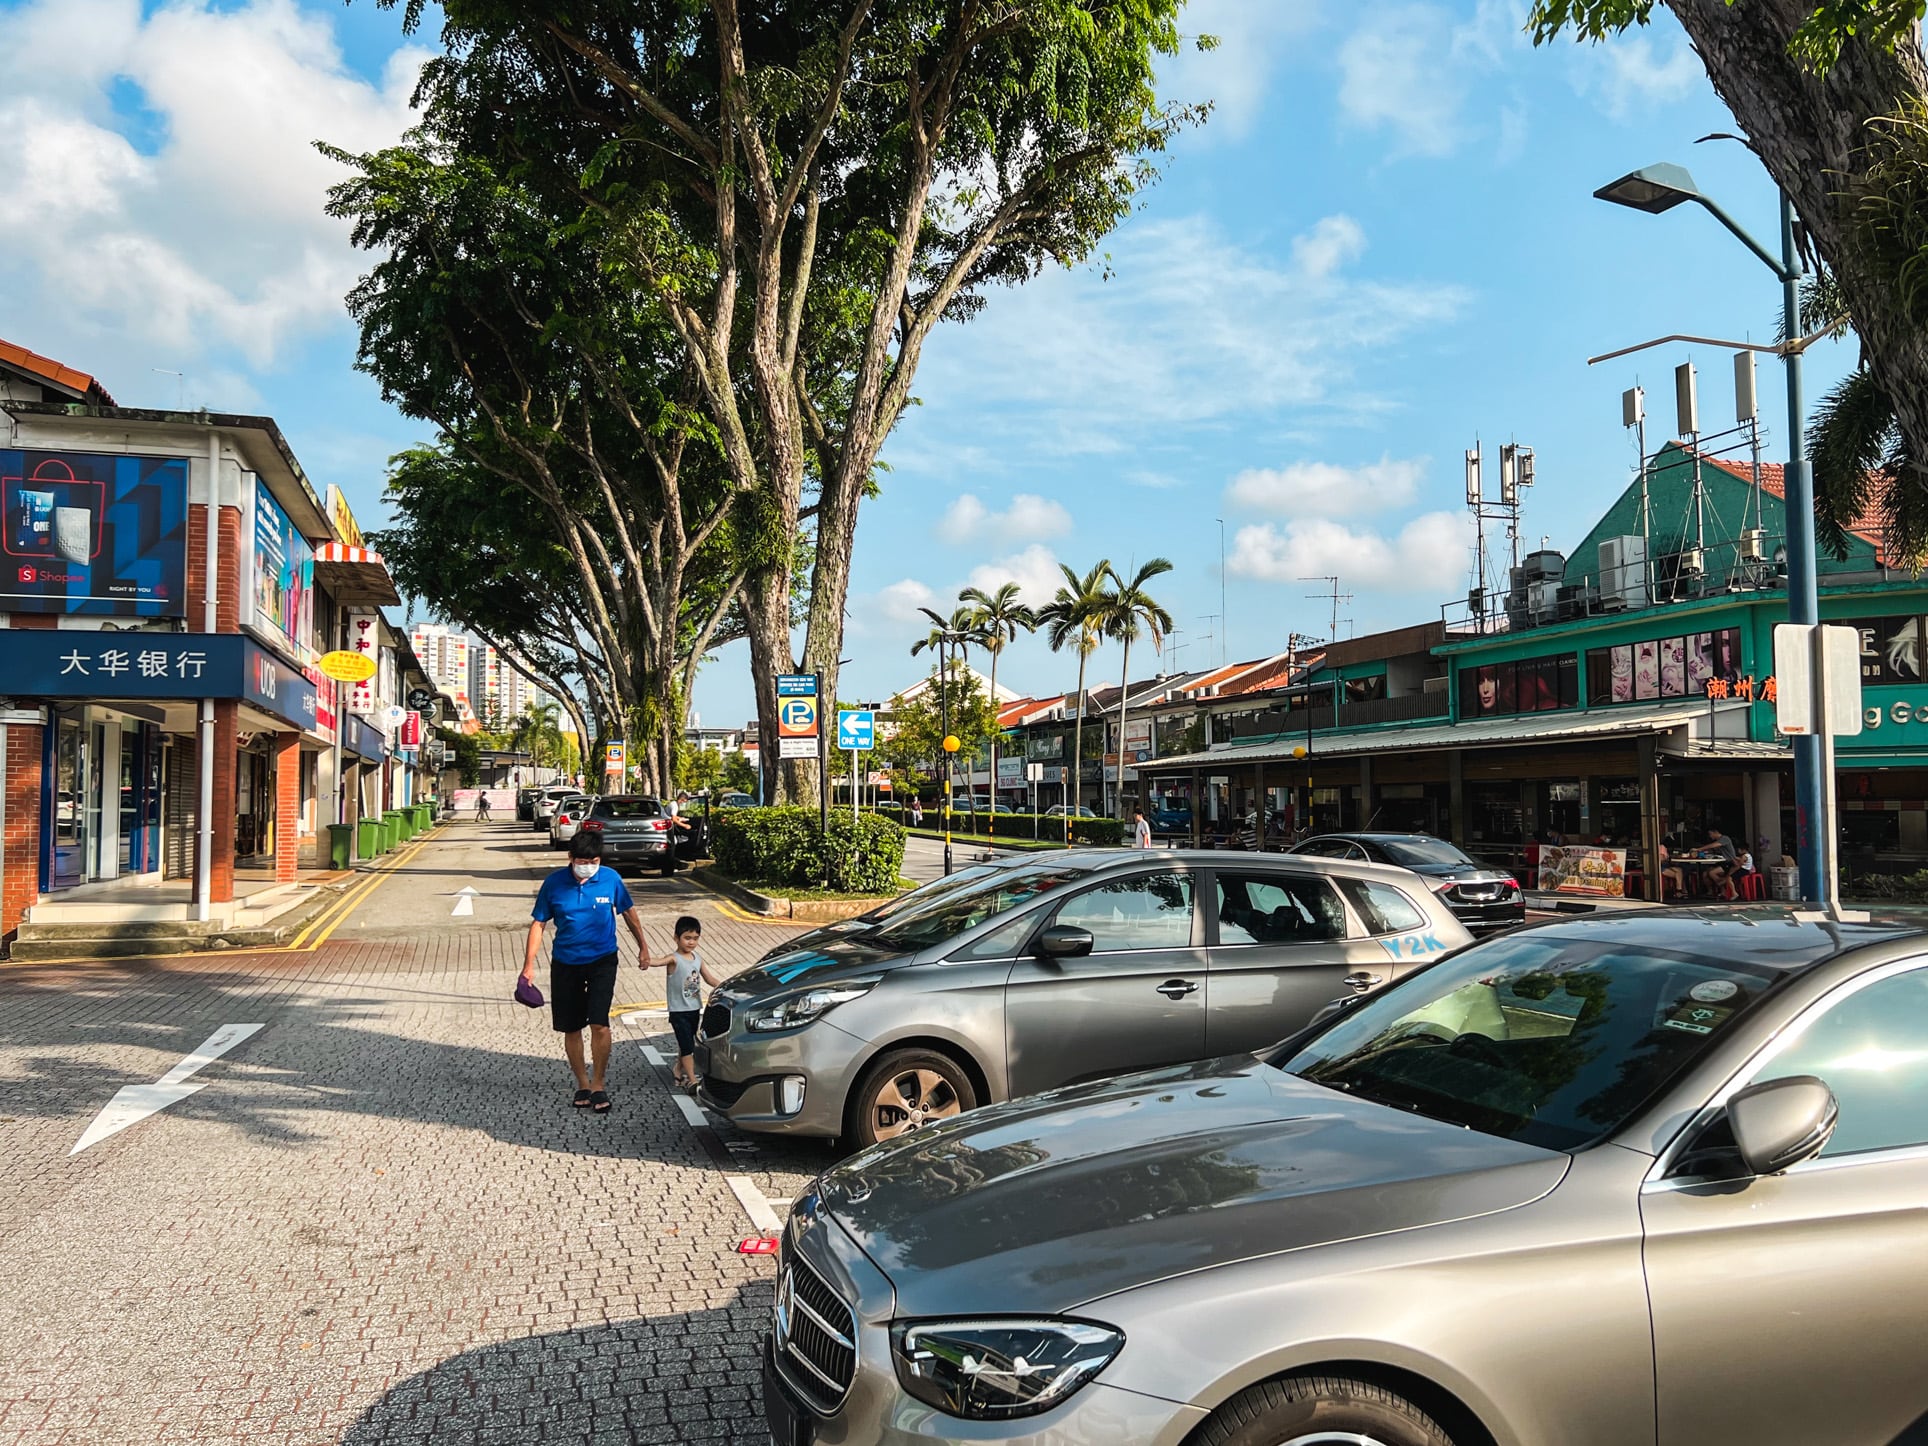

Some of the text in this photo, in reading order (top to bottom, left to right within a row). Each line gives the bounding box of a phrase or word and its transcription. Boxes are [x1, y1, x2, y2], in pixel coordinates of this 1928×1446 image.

[40, 571, 85, 583] Shopee
[59, 648, 207, 679] 大华银行
[261, 658, 277, 700] UOB
[841, 736, 871, 746] ONE WAY
[595, 896, 610, 904] Y2K
[1381, 932, 1448, 959] Y2K
